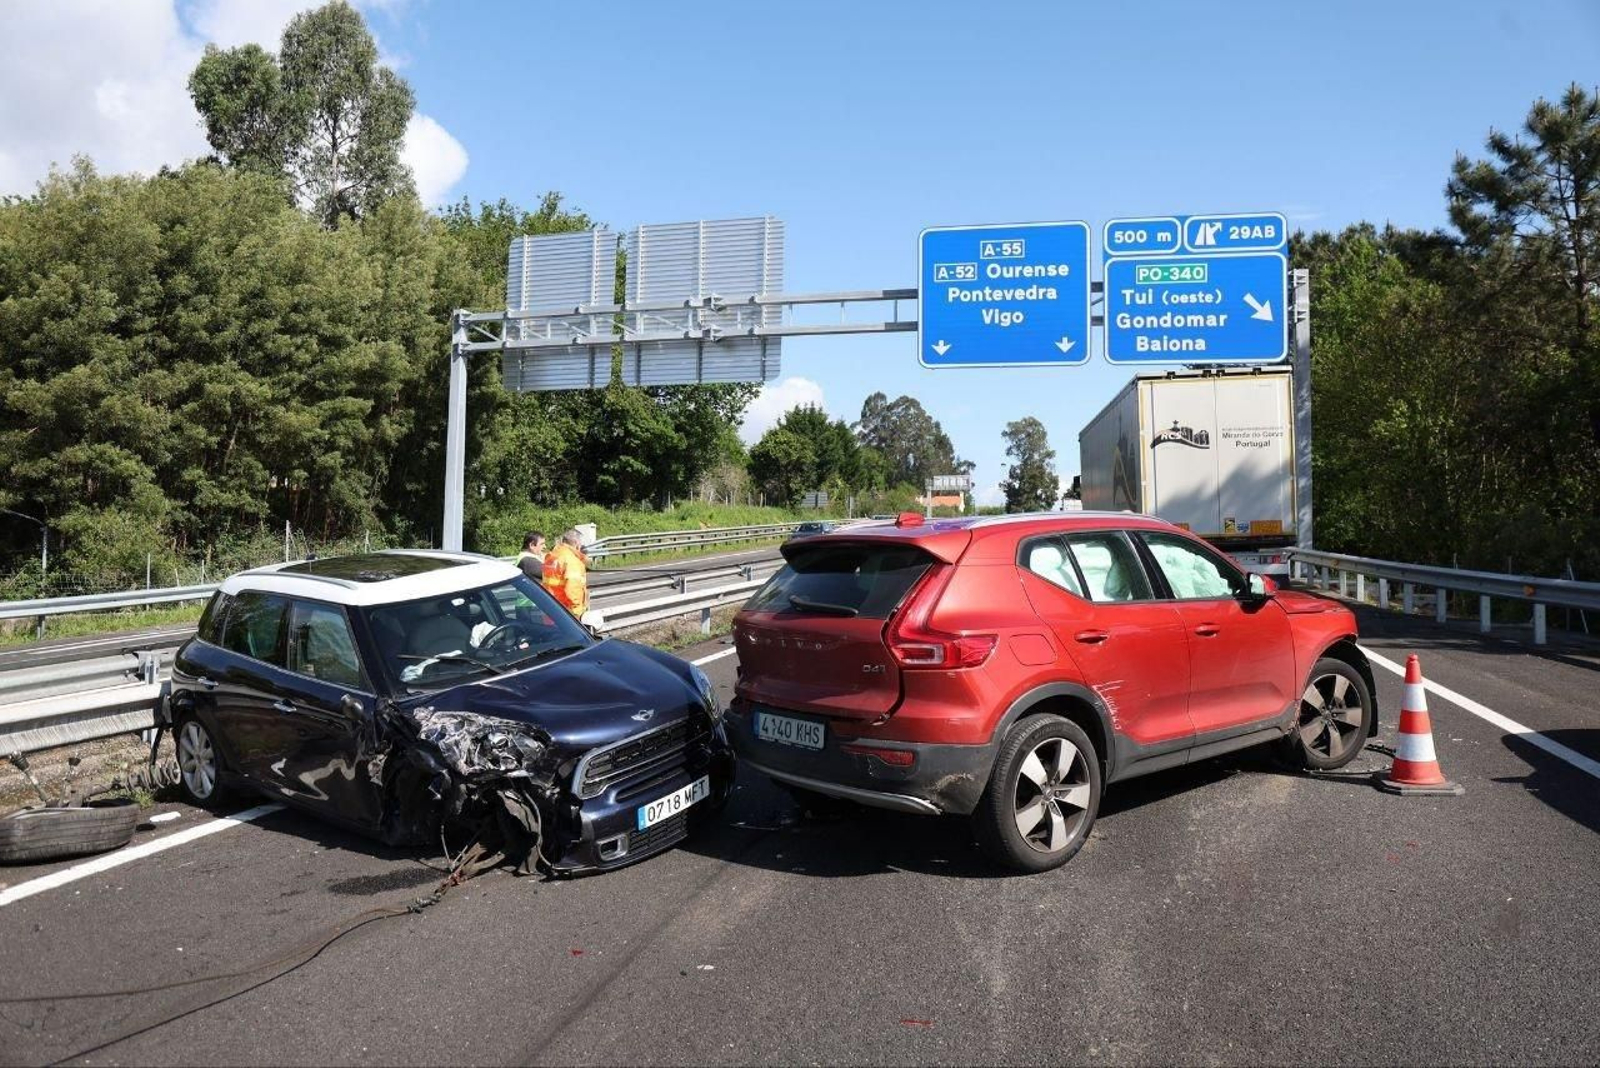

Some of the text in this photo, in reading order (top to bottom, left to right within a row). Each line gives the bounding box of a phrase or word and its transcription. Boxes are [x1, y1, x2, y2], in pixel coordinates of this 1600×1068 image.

[1114, 230, 1172, 244] 500 m
[1229, 226, 1275, 240] 29AB
[983, 243, 1022, 257] A-55
[937, 263, 1069, 279] A-52 Ourense
[1138, 266, 1205, 281] PO-340
[948, 286, 1057, 302] Pontevedra
[1121, 289, 1222, 305] Tui (oeste)
[981, 308, 1024, 327] Vigo
[1116, 312, 1227, 329] Gondomar
[1136, 335, 1206, 351] Baiona
[1235, 440, 1271, 448] Portugal
[761, 716, 820, 744] 4140 KHS
[648, 779, 706, 822] 0718 MFT
